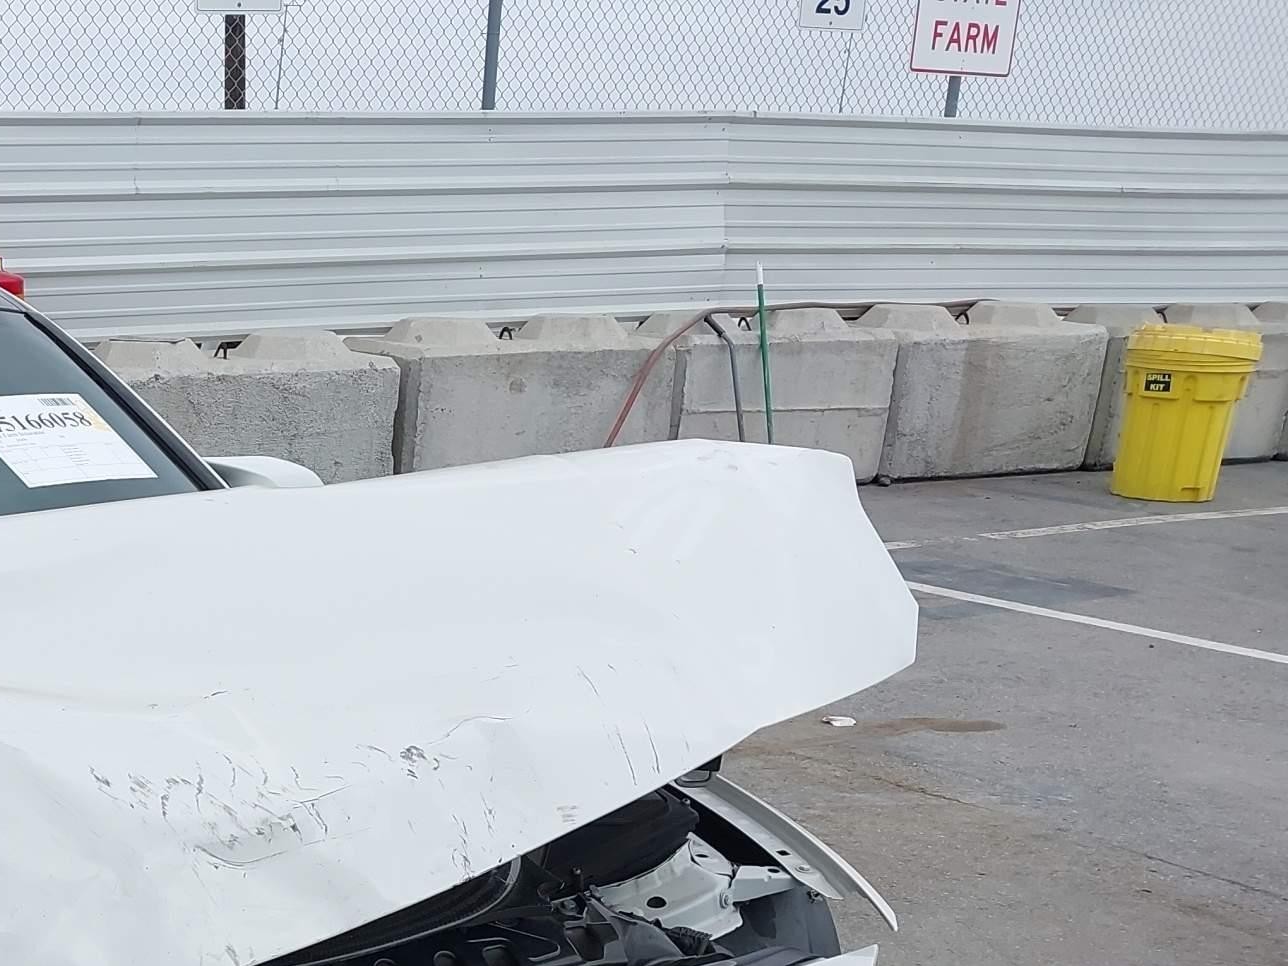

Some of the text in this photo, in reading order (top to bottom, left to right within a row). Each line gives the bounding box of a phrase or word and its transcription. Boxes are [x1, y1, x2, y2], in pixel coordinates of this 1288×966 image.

[931, 20, 999, 55] FARM
[1147, 374, 1170, 382] SPILL
[1149, 383, 1165, 391] KIT
